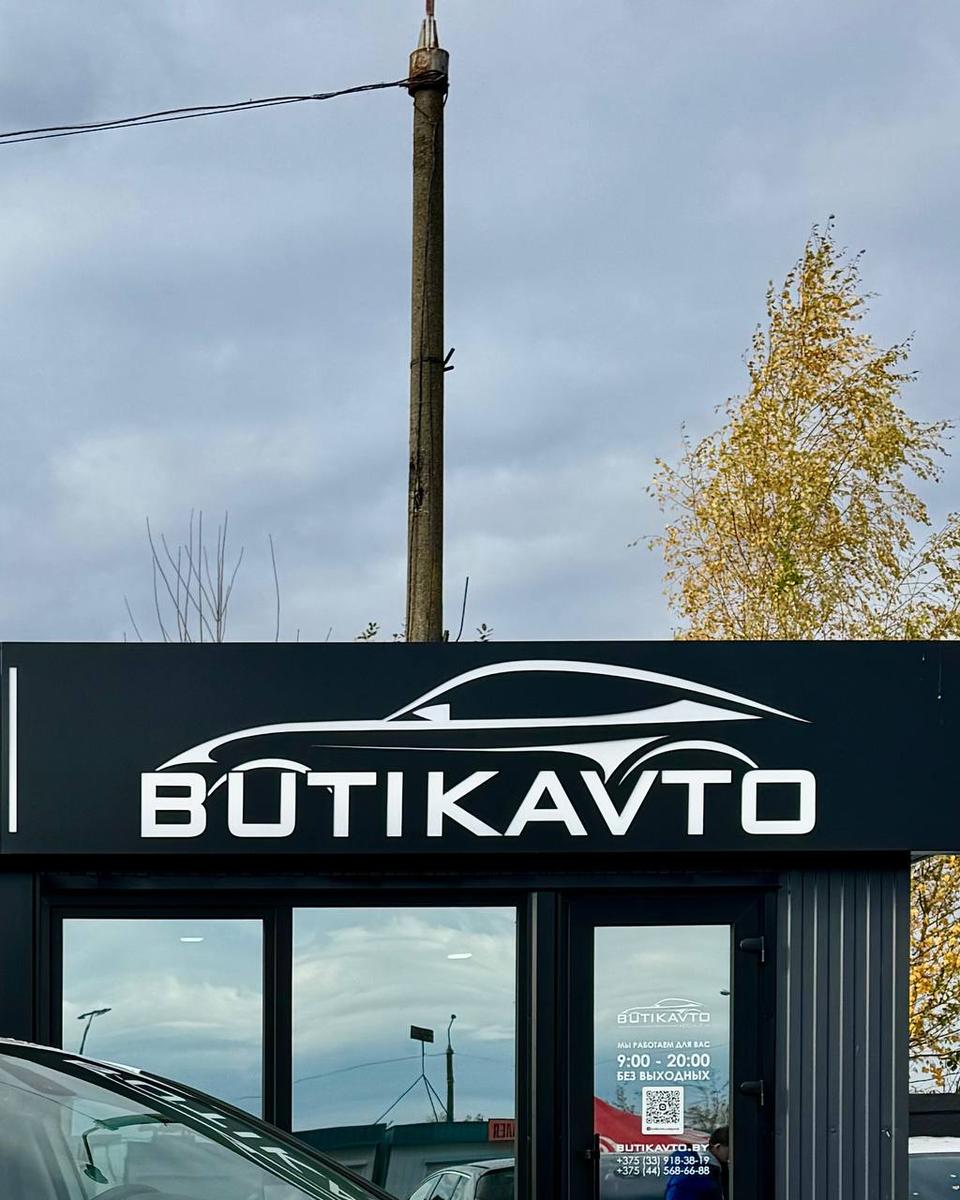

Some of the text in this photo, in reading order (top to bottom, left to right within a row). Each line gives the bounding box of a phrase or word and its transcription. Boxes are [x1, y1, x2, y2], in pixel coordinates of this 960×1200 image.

[140, 769, 817, 838] BUTIKAVTO
[617, 1012, 711, 1024] BUTIKAVTO
[617, 1041, 632, 1049] МЫ
[633, 1041, 674, 1049] РАБОТАЕМ
[675, 1041, 692, 1049] ДЛЯ
[617, 1054, 651, 1068] 9:00
[667, 1053, 711, 1068] 20:00
[617, 1070, 711, 1082] БЕЗ ВЫХОДНЫХ
[617, 1143, 710, 1152] BUTIKAVTO.BY
[616, 1156, 710, 1167] +375 (33) 918-38-19
[616, 1166, 710, 1177] +375 (44) 568-66-88
